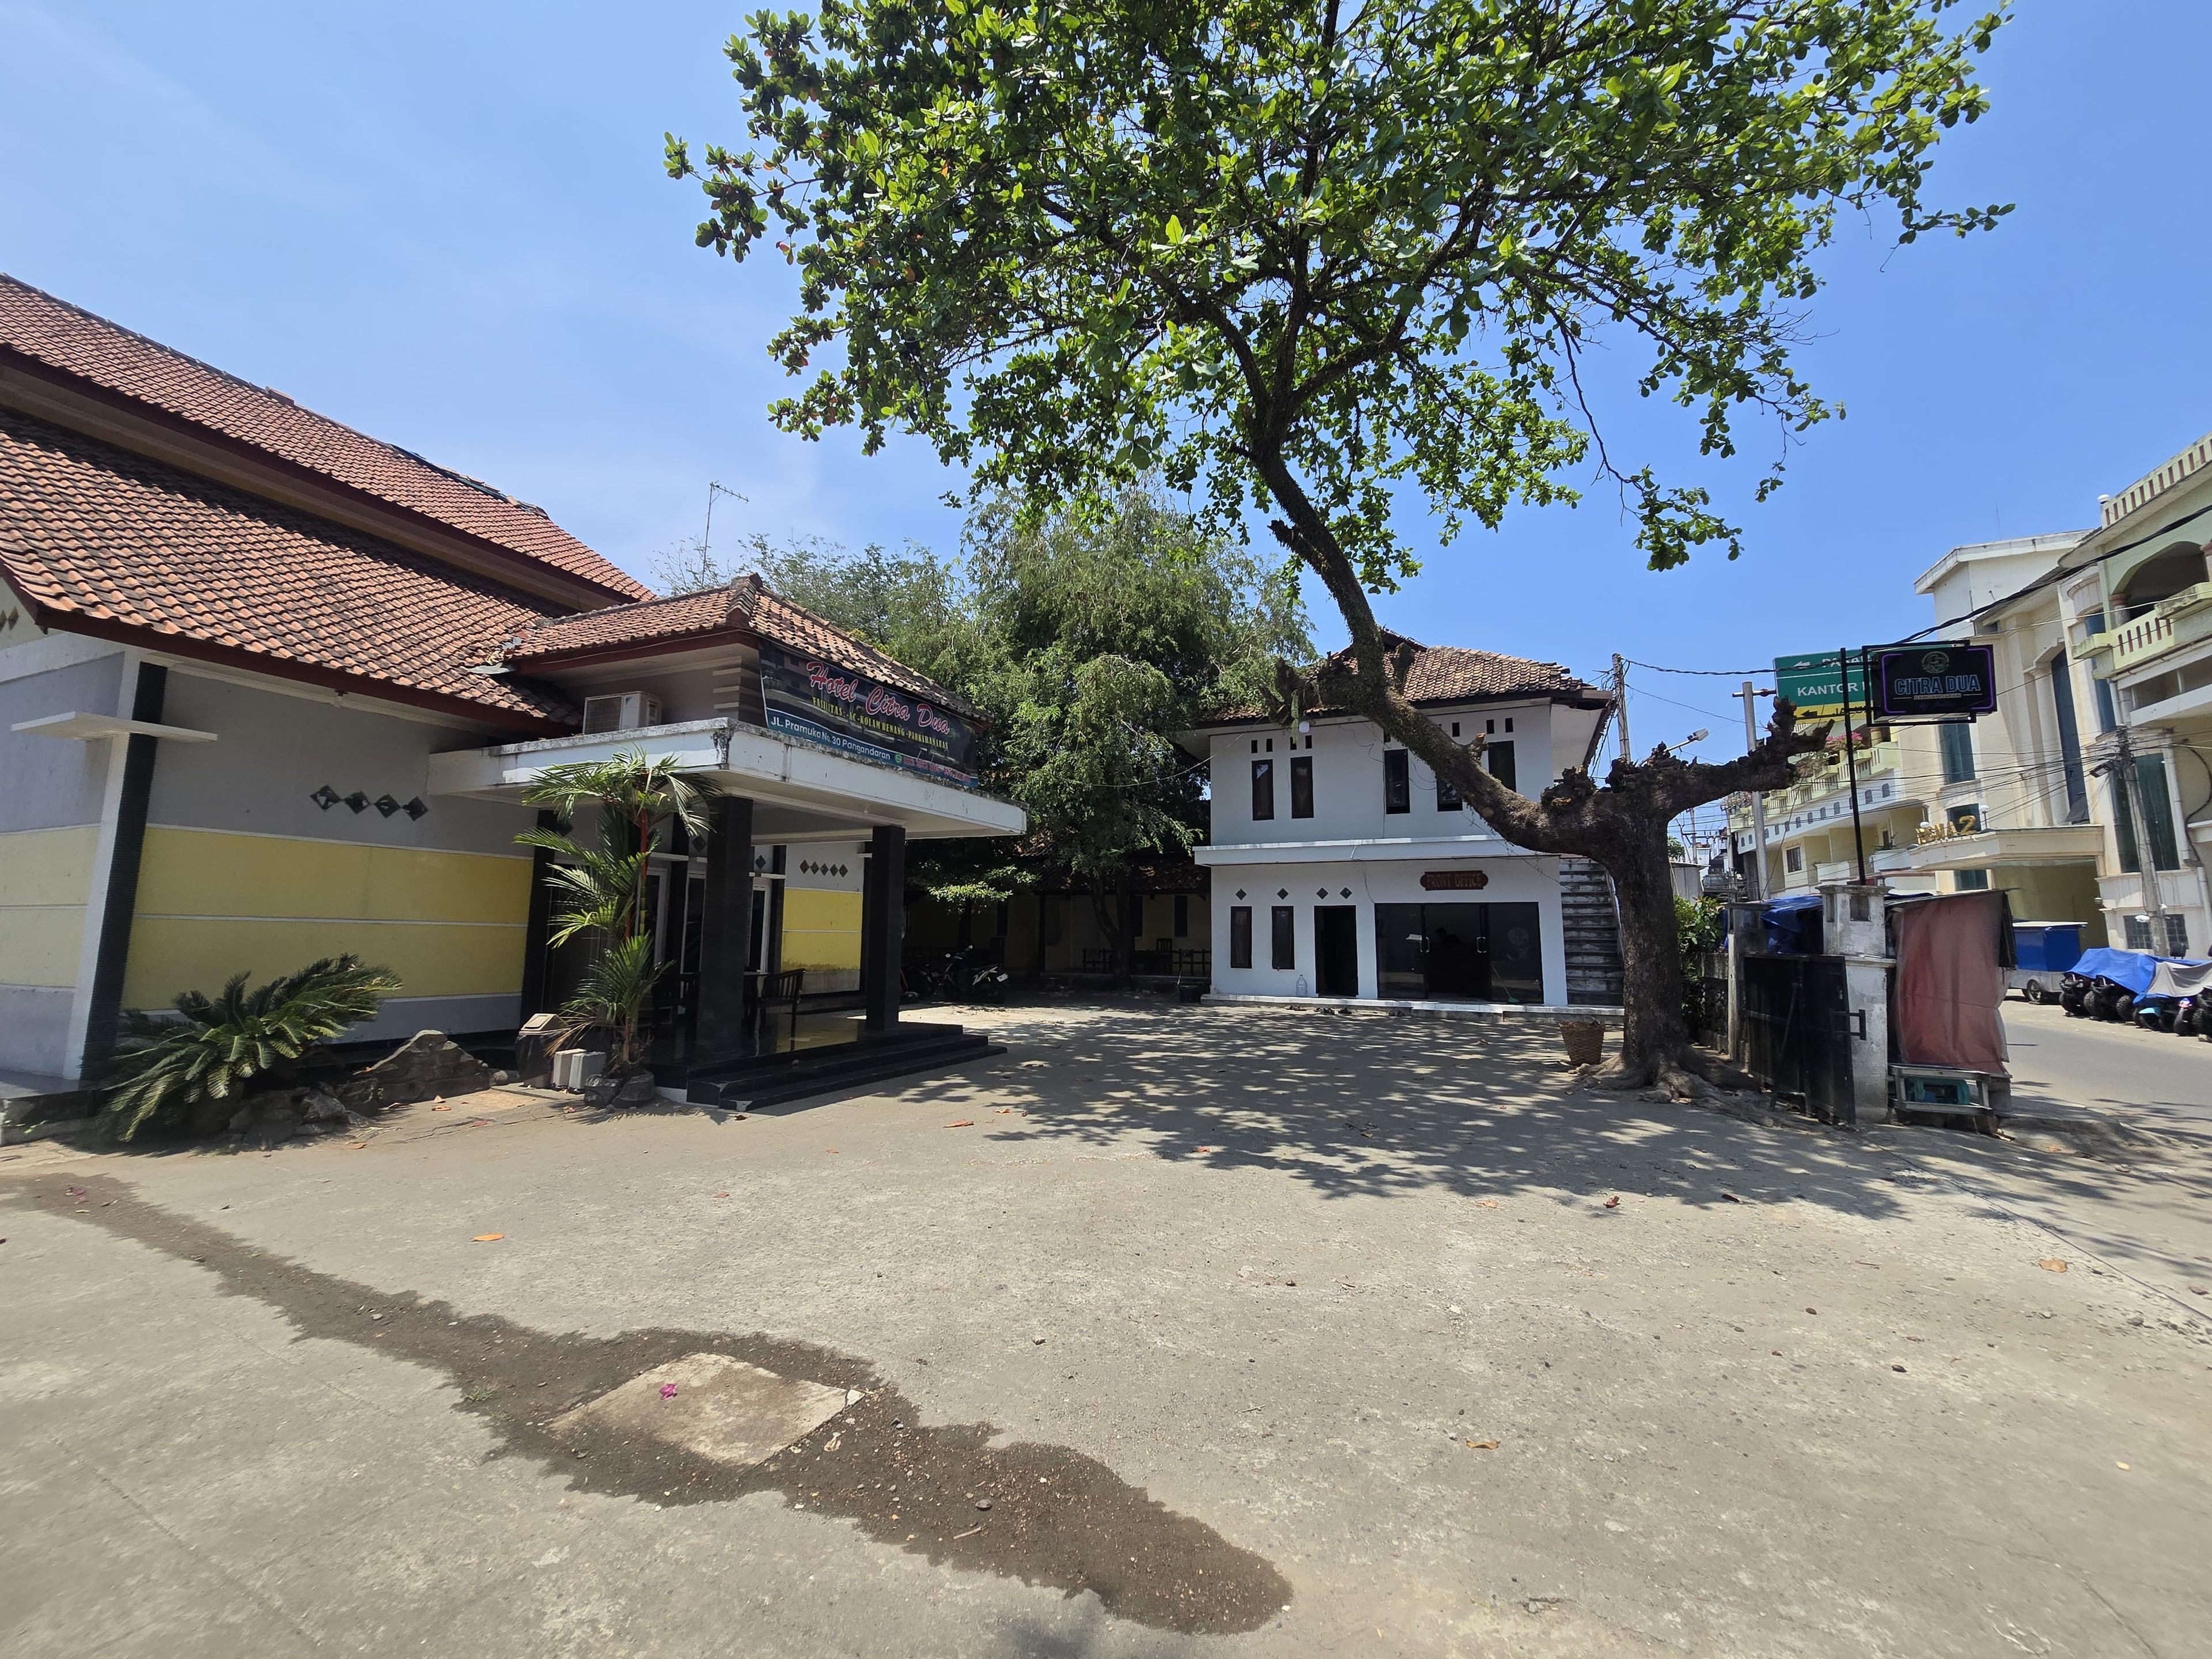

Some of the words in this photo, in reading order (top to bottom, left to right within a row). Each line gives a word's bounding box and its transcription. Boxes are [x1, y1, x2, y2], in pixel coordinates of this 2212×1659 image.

[1797, 681, 1858, 697] KANTOR
[1894, 676, 1943, 695] CITRA
[1945, 674, 1981, 693] DUA
[807, 661, 858, 703] Hotel
[865, 686, 910, 721] Citra
[917, 703, 950, 734] Dua
[771, 716, 783, 728] JL.
[785, 719, 821, 738] Pramuka
[822, 731, 831, 743] No.
[832, 736, 841, 747] 30
[842, 739, 891, 760] Pangandaran
[882, 722, 905, 737] RENANG
[1958, 815, 1978, 836] 2
[1426, 873, 1451, 888] FRONT
[1455, 873, 1482, 887] OFFICE
